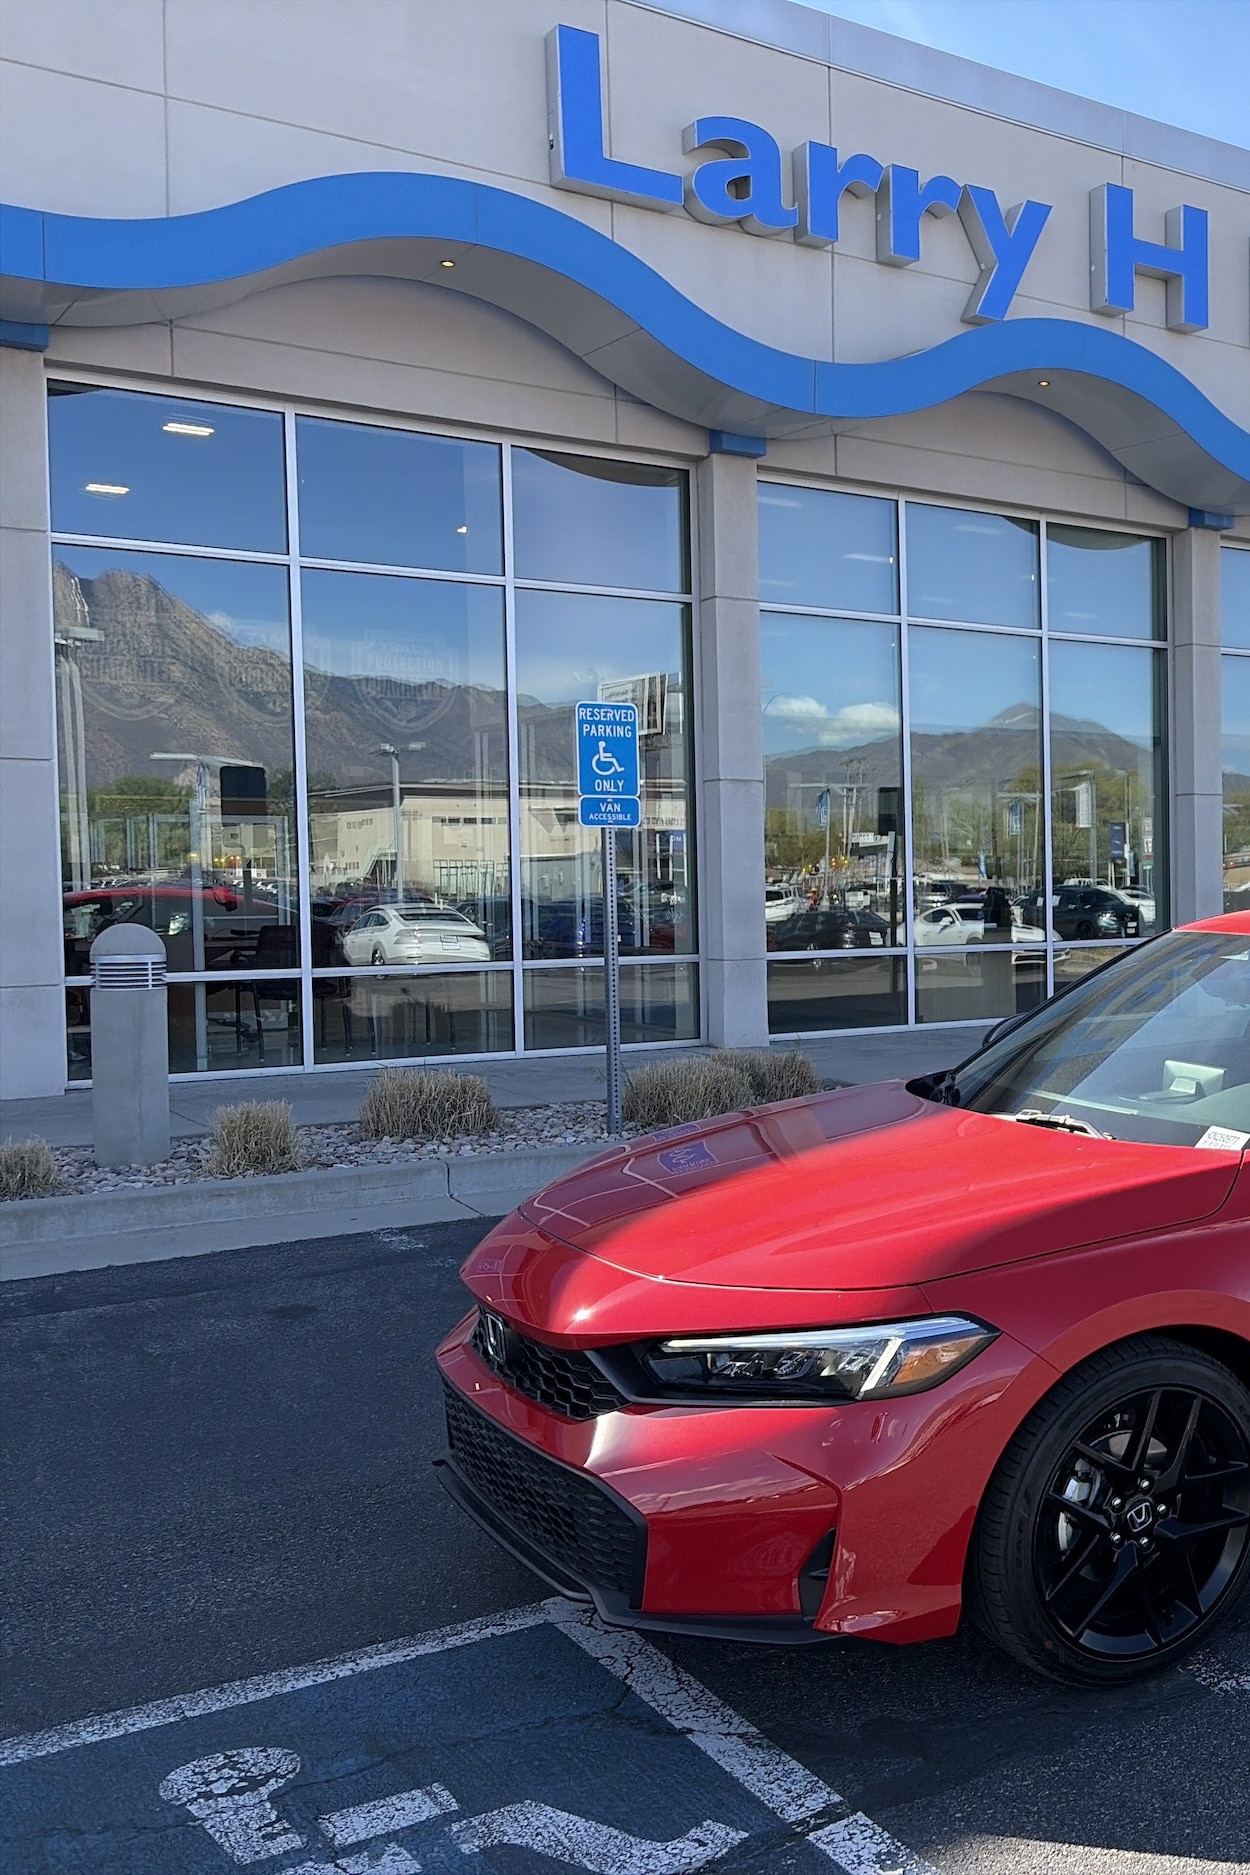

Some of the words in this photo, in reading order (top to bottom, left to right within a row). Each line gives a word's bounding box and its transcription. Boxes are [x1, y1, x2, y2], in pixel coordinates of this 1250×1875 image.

[546, 23, 1052, 325] Larry
[1090, 183, 1209, 333] H
[579, 707, 635, 722] RESERVED
[583, 724, 632, 738] PARKING
[595, 779, 624, 792] ONLY
[600, 803, 621, 813] VAN
[589, 813, 631, 821] ACCESSIBLE
